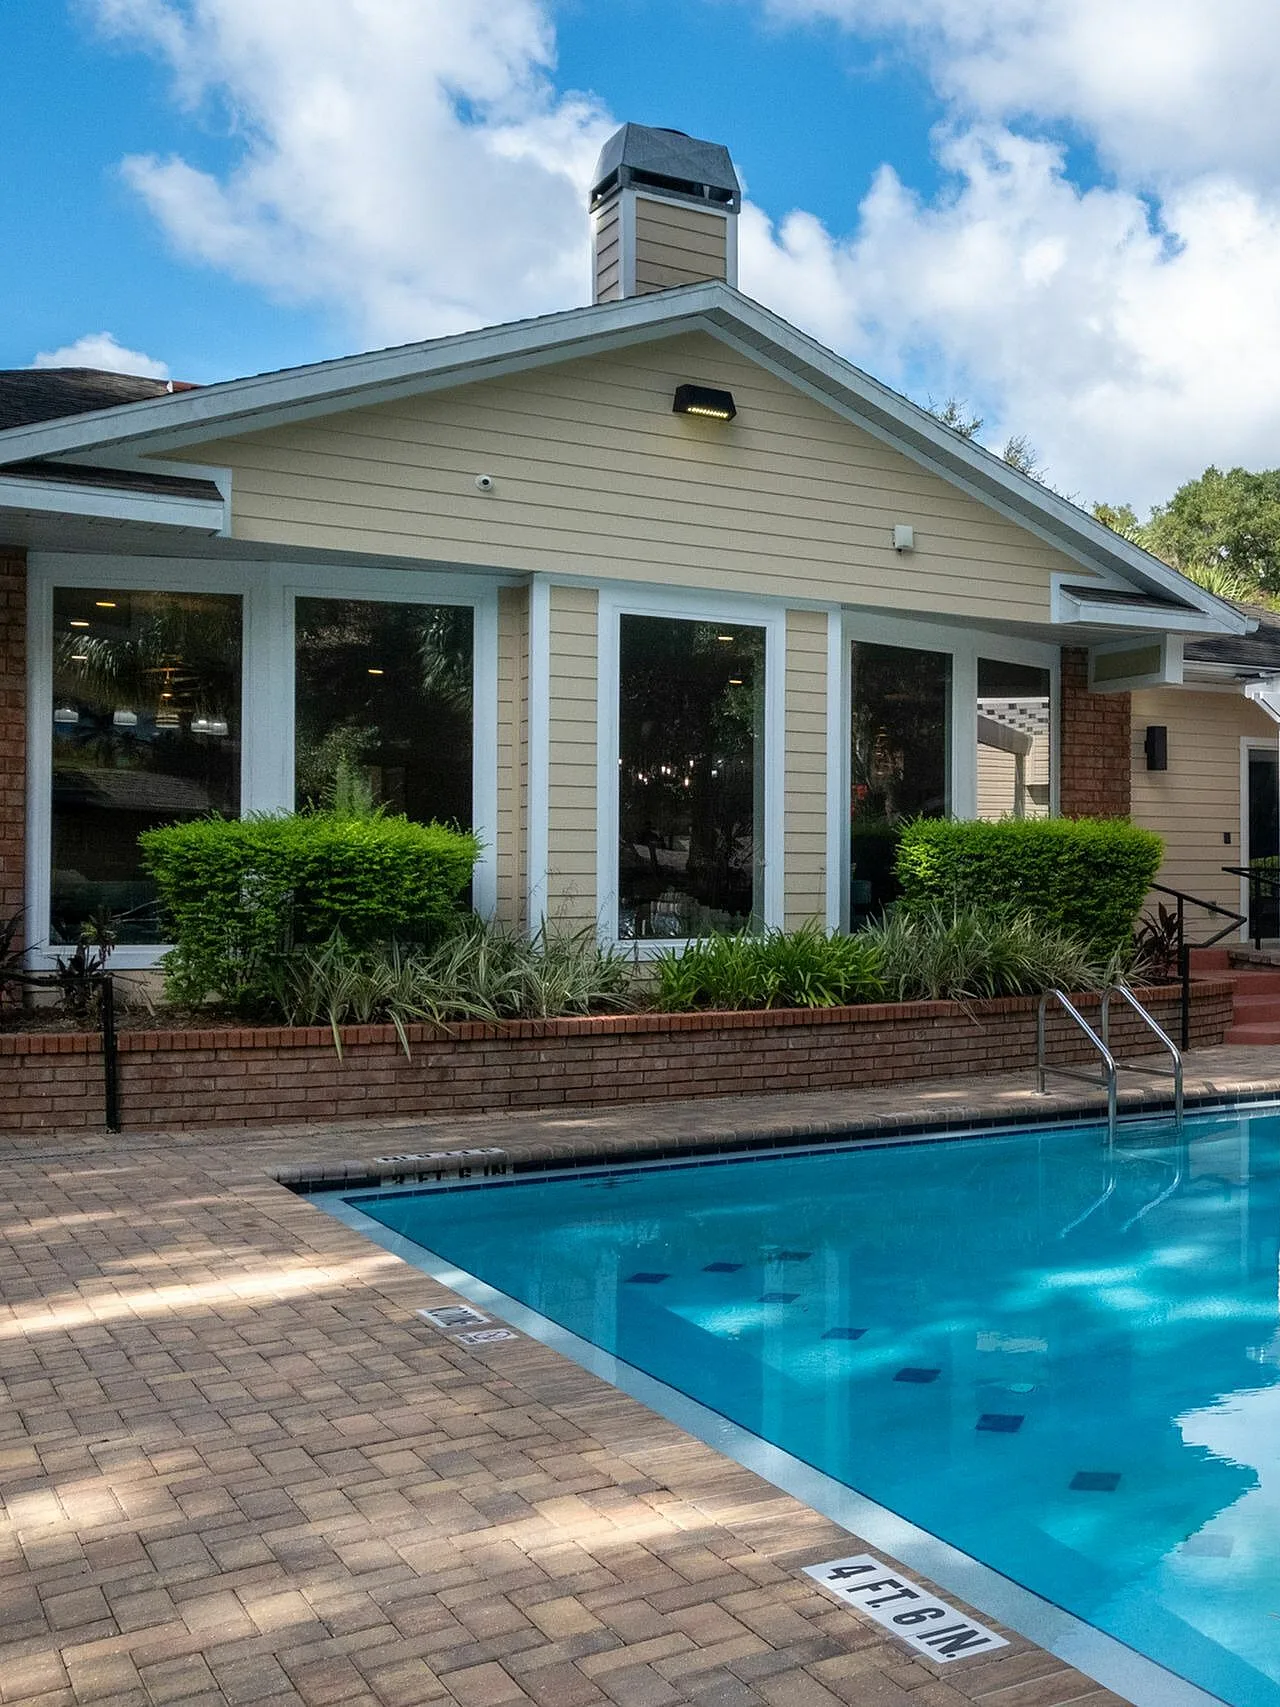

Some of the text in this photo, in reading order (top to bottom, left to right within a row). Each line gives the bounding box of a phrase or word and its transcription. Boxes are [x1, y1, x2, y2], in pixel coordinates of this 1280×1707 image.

[827, 1564, 993, 1659] 4 FT. 6 IN.
